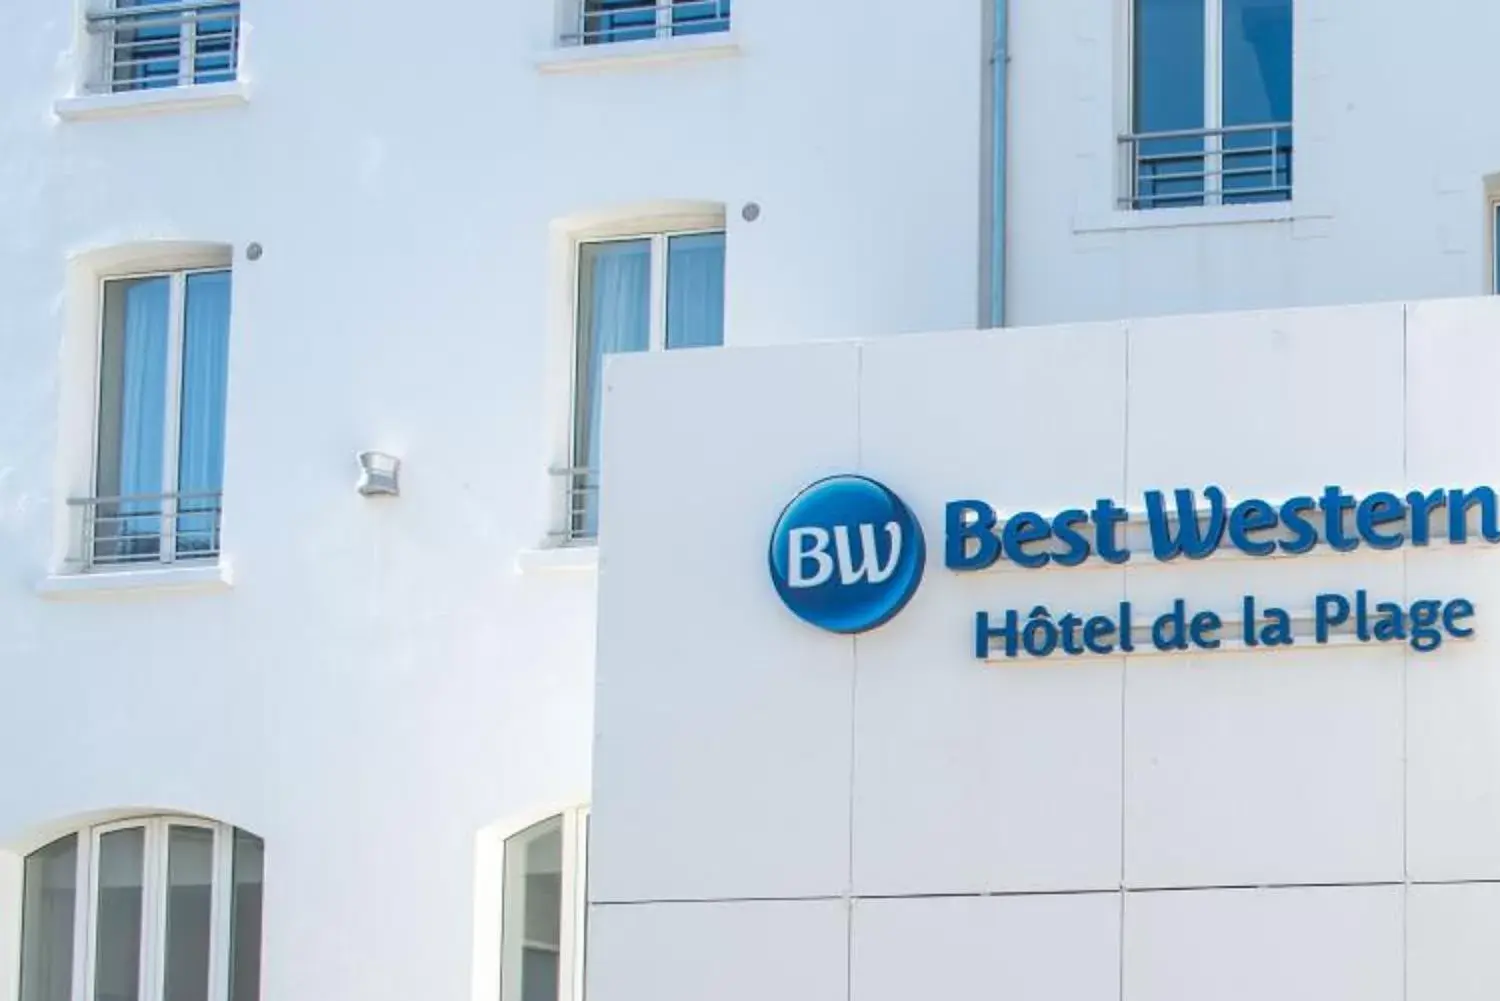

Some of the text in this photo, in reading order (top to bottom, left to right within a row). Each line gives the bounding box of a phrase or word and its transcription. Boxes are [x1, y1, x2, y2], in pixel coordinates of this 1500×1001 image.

[786, 522, 904, 589] BW
[944, 498, 1131, 571] Best
[975, 589, 1476, 660] Hôtel de la Plage
